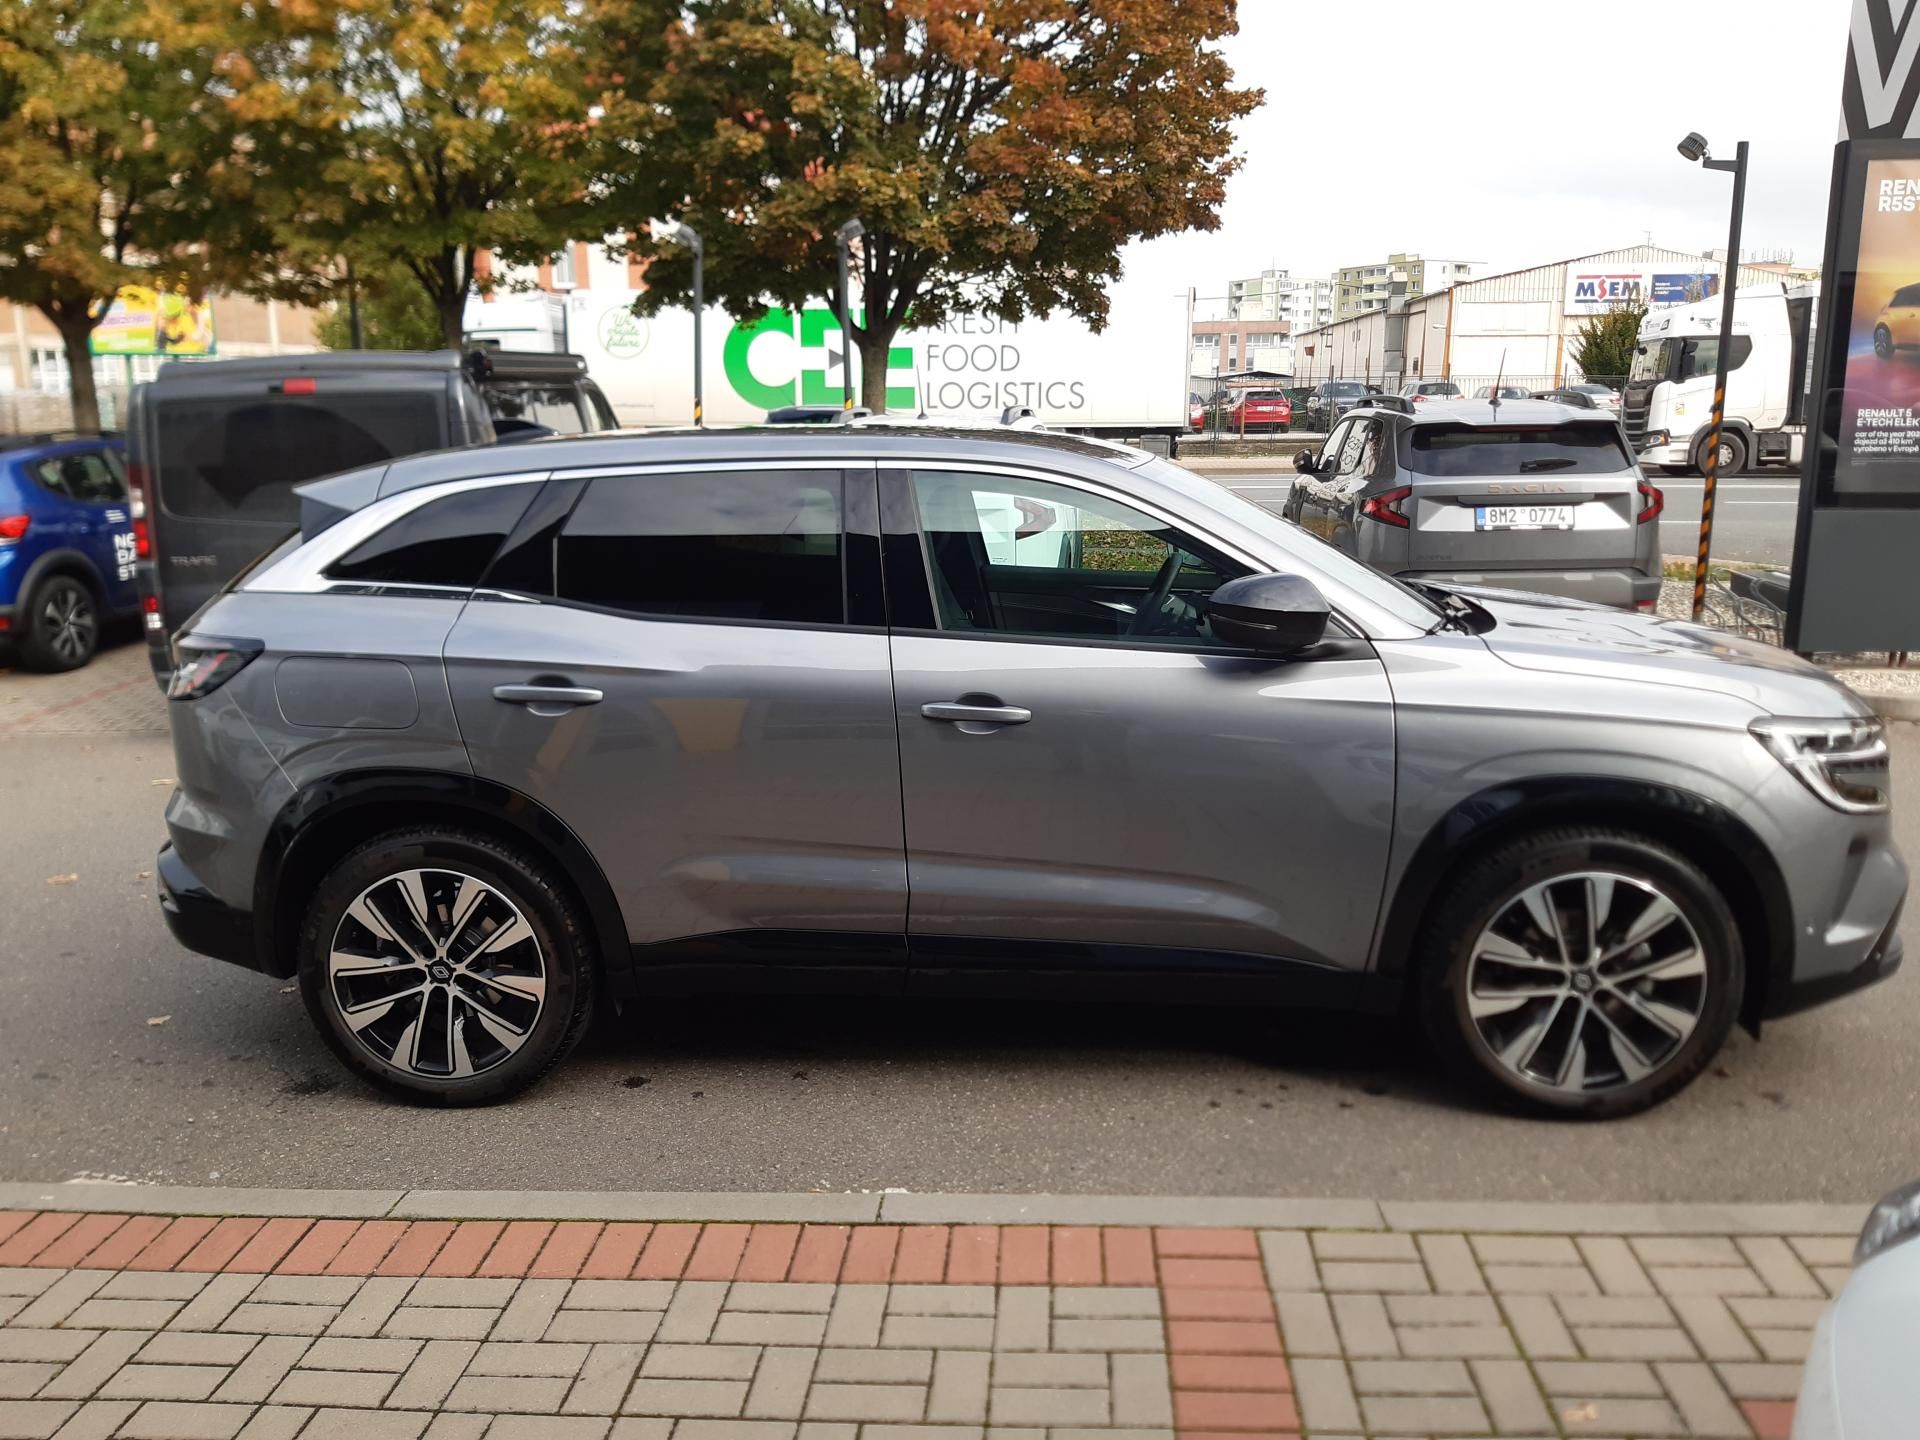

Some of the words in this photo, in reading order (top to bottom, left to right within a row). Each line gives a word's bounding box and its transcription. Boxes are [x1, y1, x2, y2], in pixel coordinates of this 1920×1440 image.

[1576, 279, 1640, 300] MSEM
[927, 307, 1018, 334] RES
[927, 344, 1020, 372] FOOD
[926, 381, 1085, 410] LOGISTICS
[1856, 417, 1893, 427] E-TECH
[1857, 408, 1905, 418] RENAULT
[1489, 508, 1517, 524] 8M2
[1529, 507, 1566, 523] 0774
